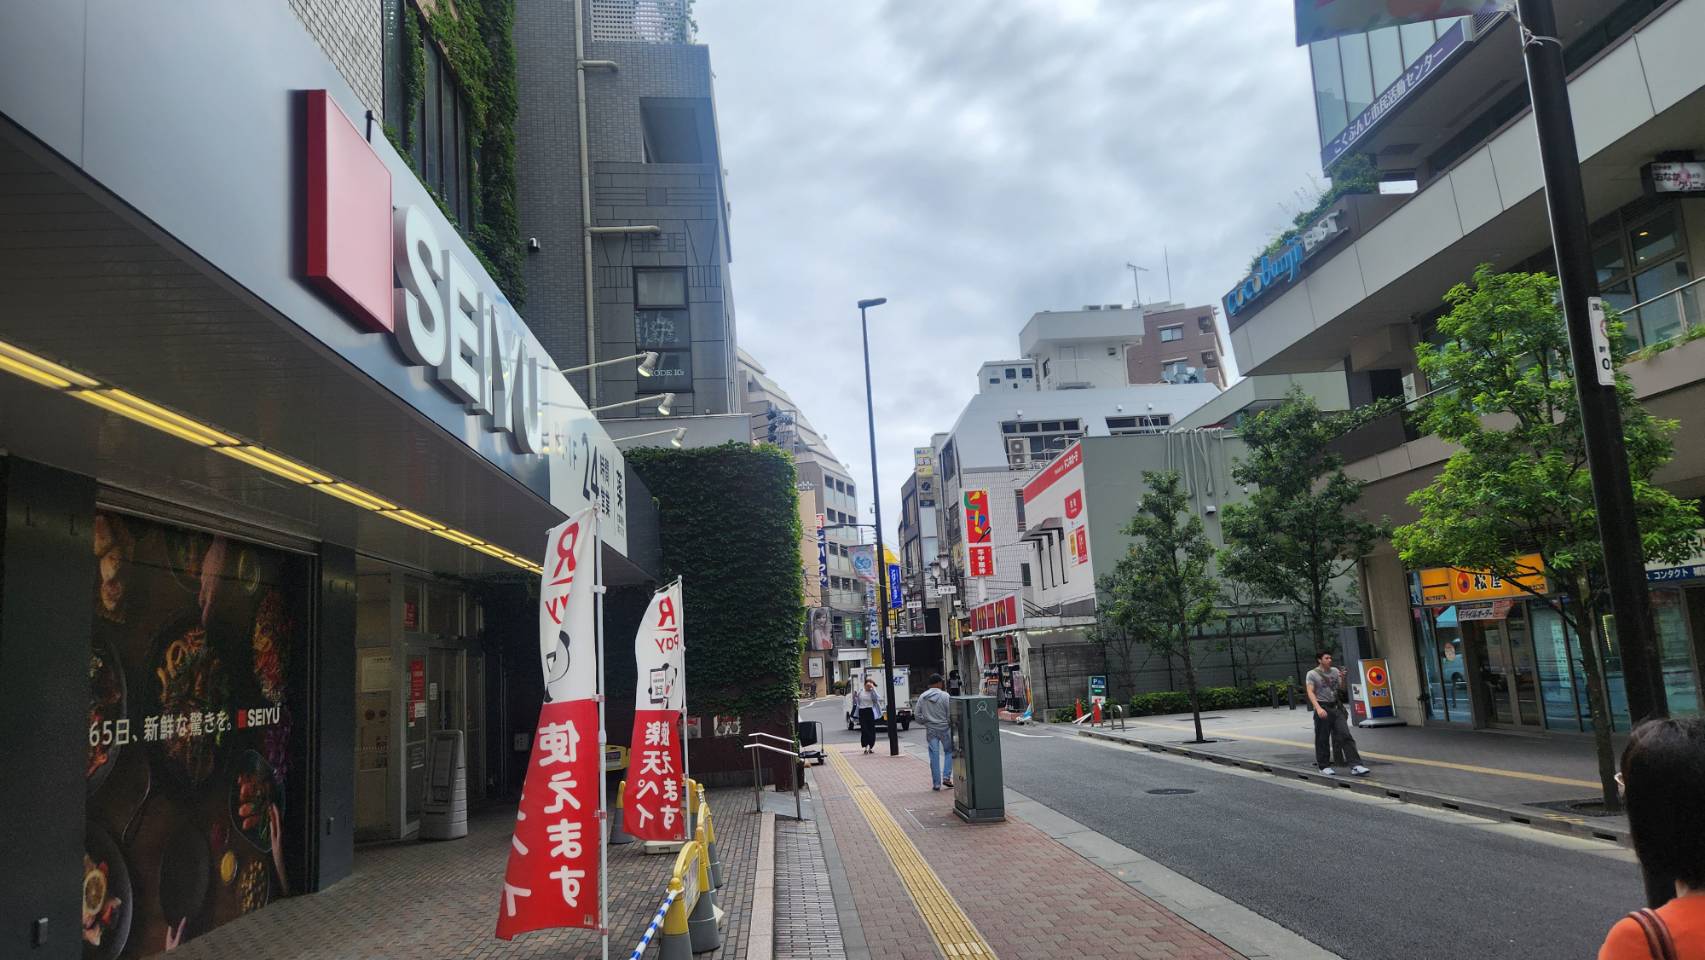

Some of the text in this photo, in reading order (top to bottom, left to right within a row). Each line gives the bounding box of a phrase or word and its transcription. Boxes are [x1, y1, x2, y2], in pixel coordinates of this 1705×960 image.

[1334, 48, 1443, 154] こくぶんじ市民活動センター
[1227, 235, 1303, 316] cocobunji
[393, 204, 542, 455] SEIYU
[582, 432, 599, 501] 24
[1654, 568, 1689, 580] コンタクト
[1460, 609, 1493, 619] モバイルオーダー
[89, 706, 280, 747] 65日、新鮮な驚きを。 SEIYU
